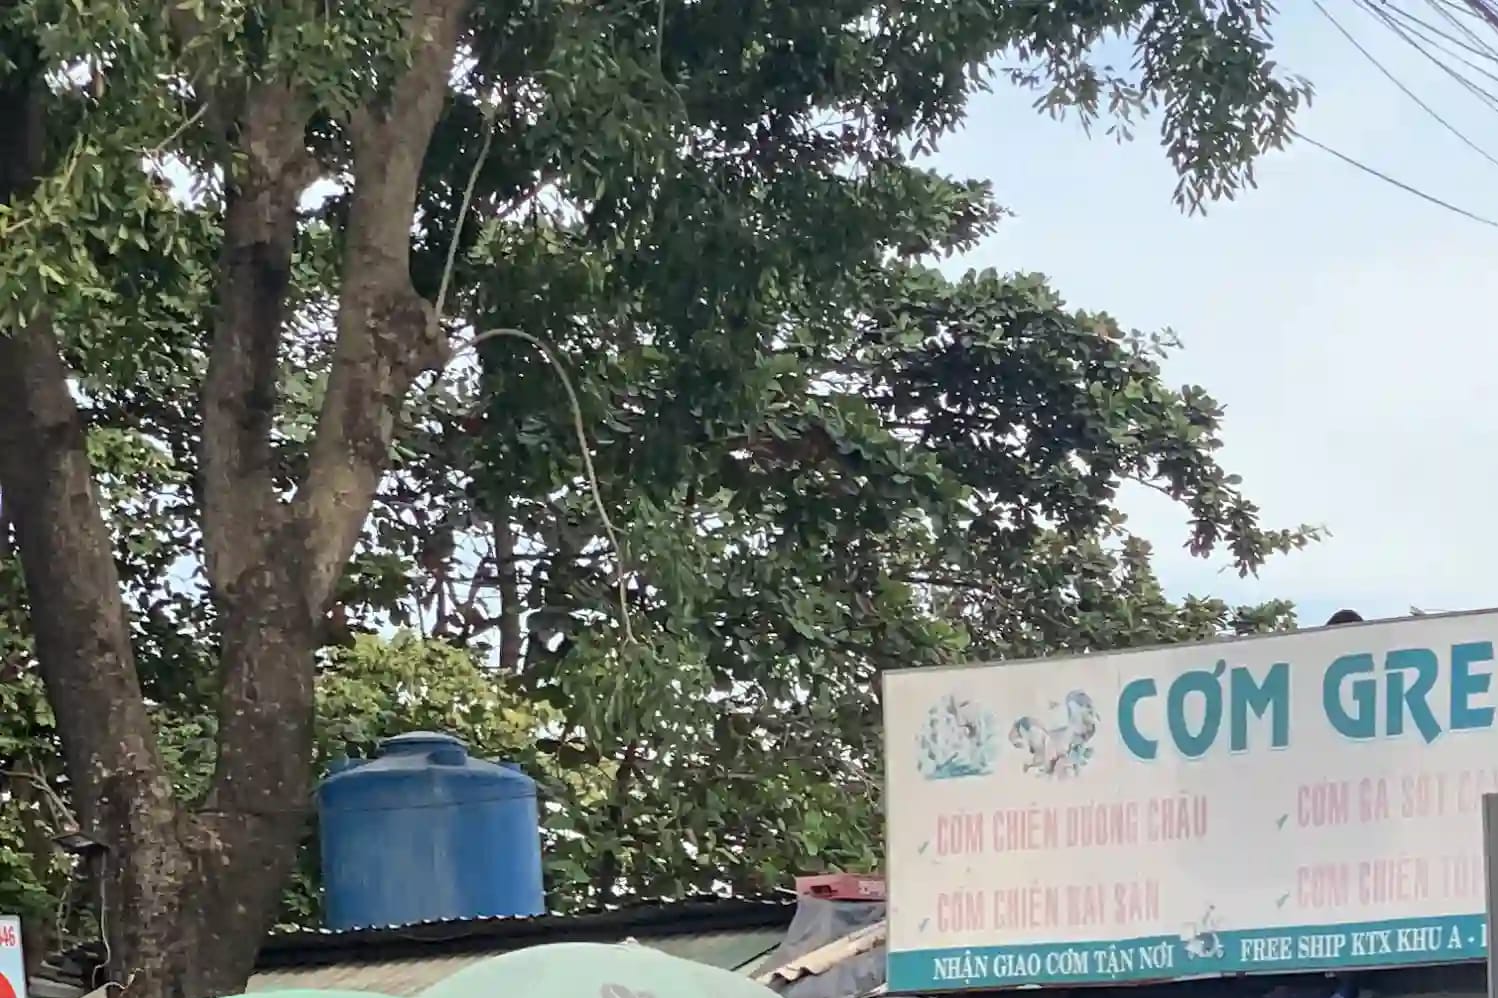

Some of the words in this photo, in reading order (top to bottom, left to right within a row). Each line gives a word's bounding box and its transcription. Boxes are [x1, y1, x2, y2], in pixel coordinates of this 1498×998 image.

[1117, 659, 1290, 760] CƠM
[933, 950, 988, 985] NHẬN
[993, 953, 1041, 978] GIAO
[1046, 948, 1089, 975] CƠM
[1095, 943, 1134, 979] TẬN
[1139, 941, 1176, 969] NƠI
[1240, 936, 1292, 962] FREE
[1297, 933, 1345, 961] SHIP
[1350, 929, 1391, 957] KTX
[1396, 926, 1442, 954] KHU
[1447, 924, 1462, 949] A
